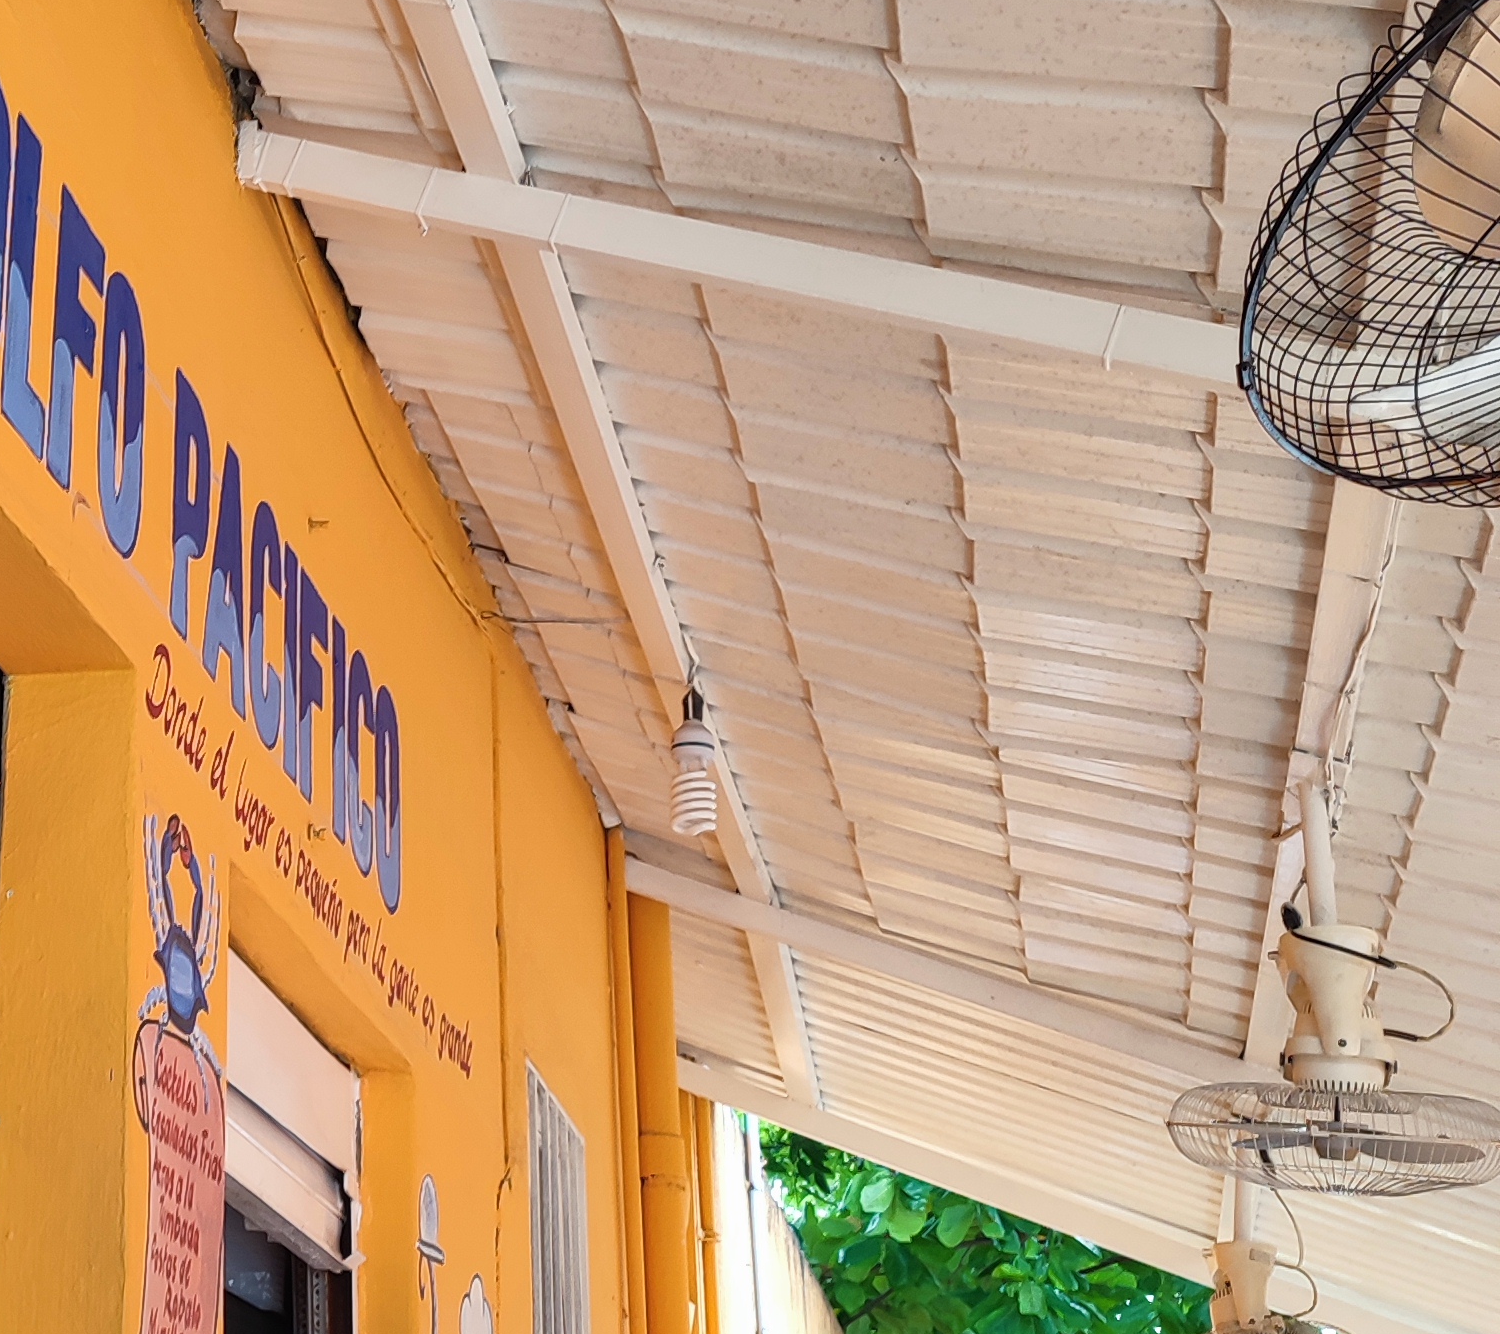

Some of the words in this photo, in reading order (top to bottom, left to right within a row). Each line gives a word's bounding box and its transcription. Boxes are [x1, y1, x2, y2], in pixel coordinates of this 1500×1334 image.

[169, 367, 401, 914] PACIFICO
[145, 643, 206, 772] Donde
[210, 730, 235, 801] el
[275, 827, 293, 880] es
[294, 848, 343, 941] pequeño
[343, 909, 370, 964] pero
[387, 961, 418, 1017] gente
[422, 995, 436, 1034] es
[437, 1013, 474, 1080] grande
[151, 1097, 198, 1165] Ensaladas
[176, 1173, 185, 1206] a
[184, 1169, 196, 1211] la
[179, 1254, 192, 1290] de
[163, 1281, 201, 1331] Robalo
